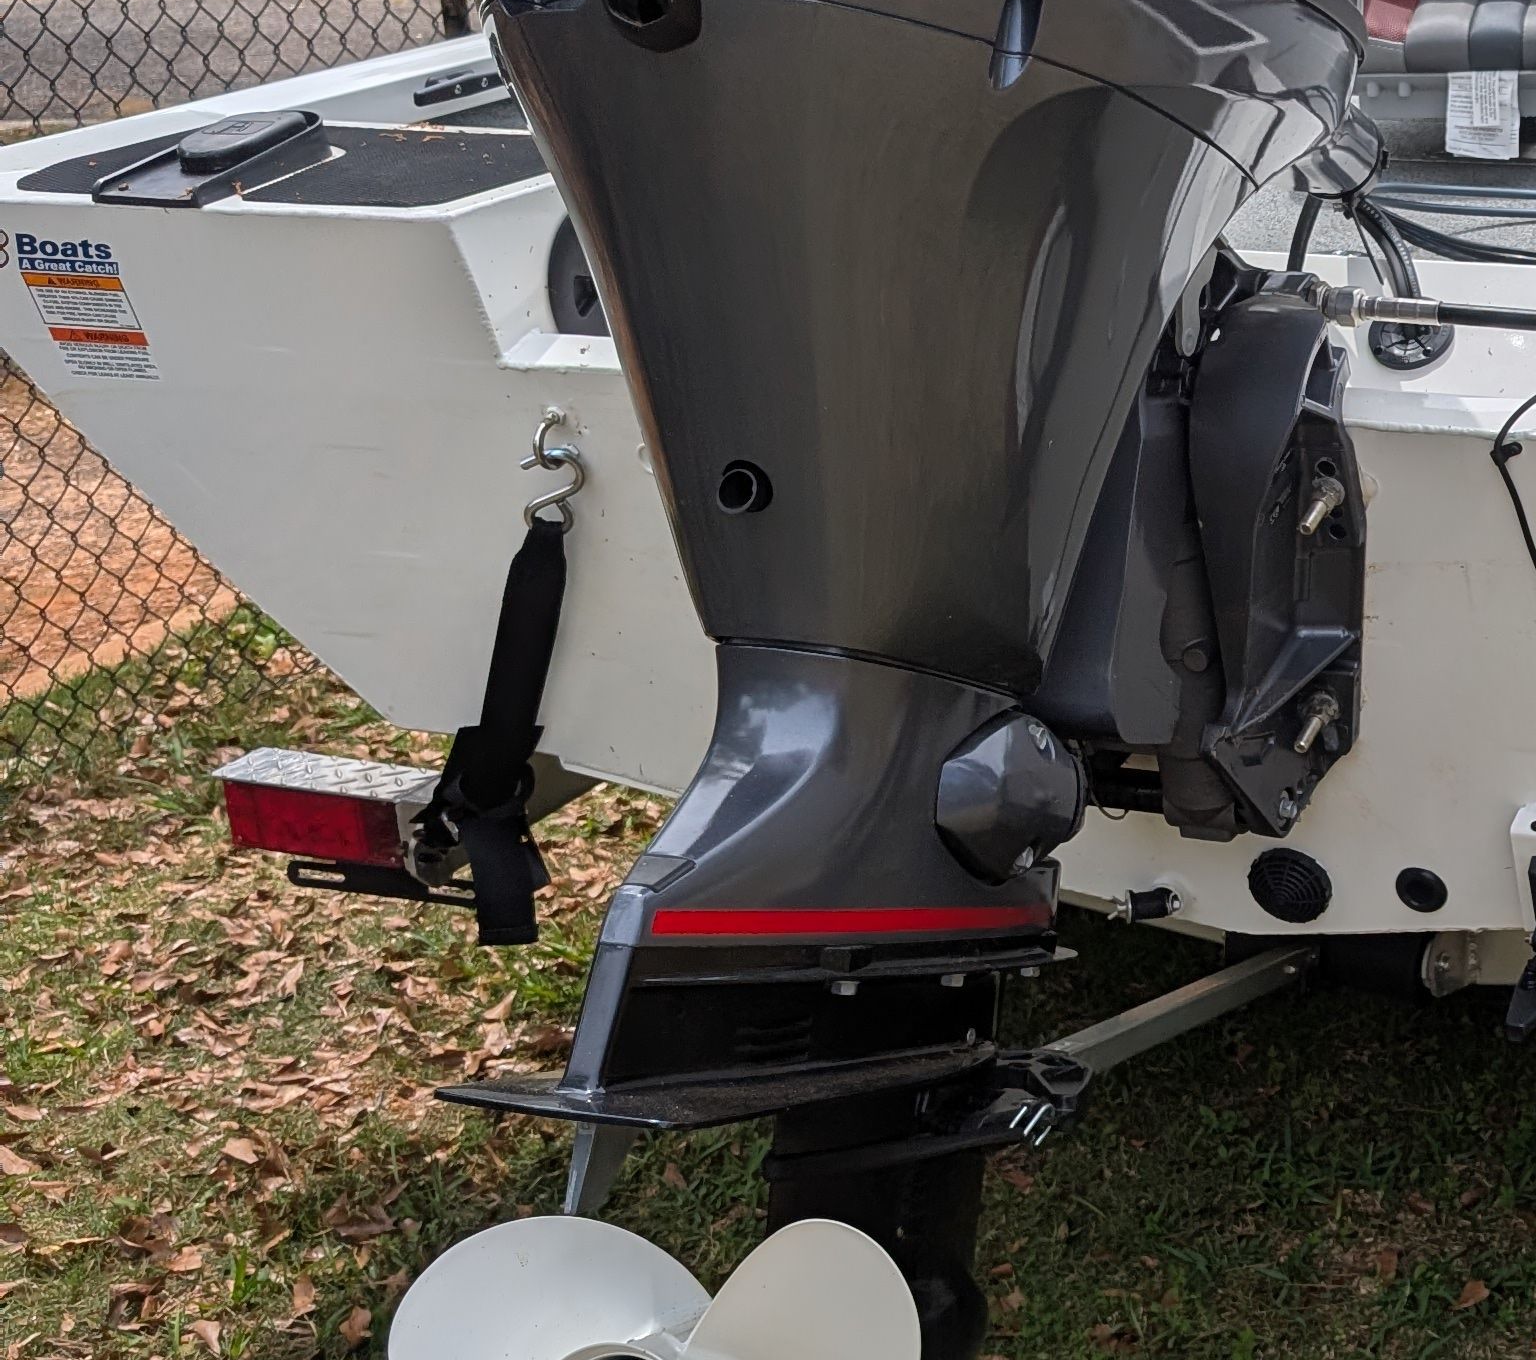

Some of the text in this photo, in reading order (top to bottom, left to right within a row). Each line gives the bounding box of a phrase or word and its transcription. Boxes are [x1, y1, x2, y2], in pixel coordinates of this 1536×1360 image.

[15, 233, 112, 260] Boats
[22, 259, 119, 275] A Great Catch!
